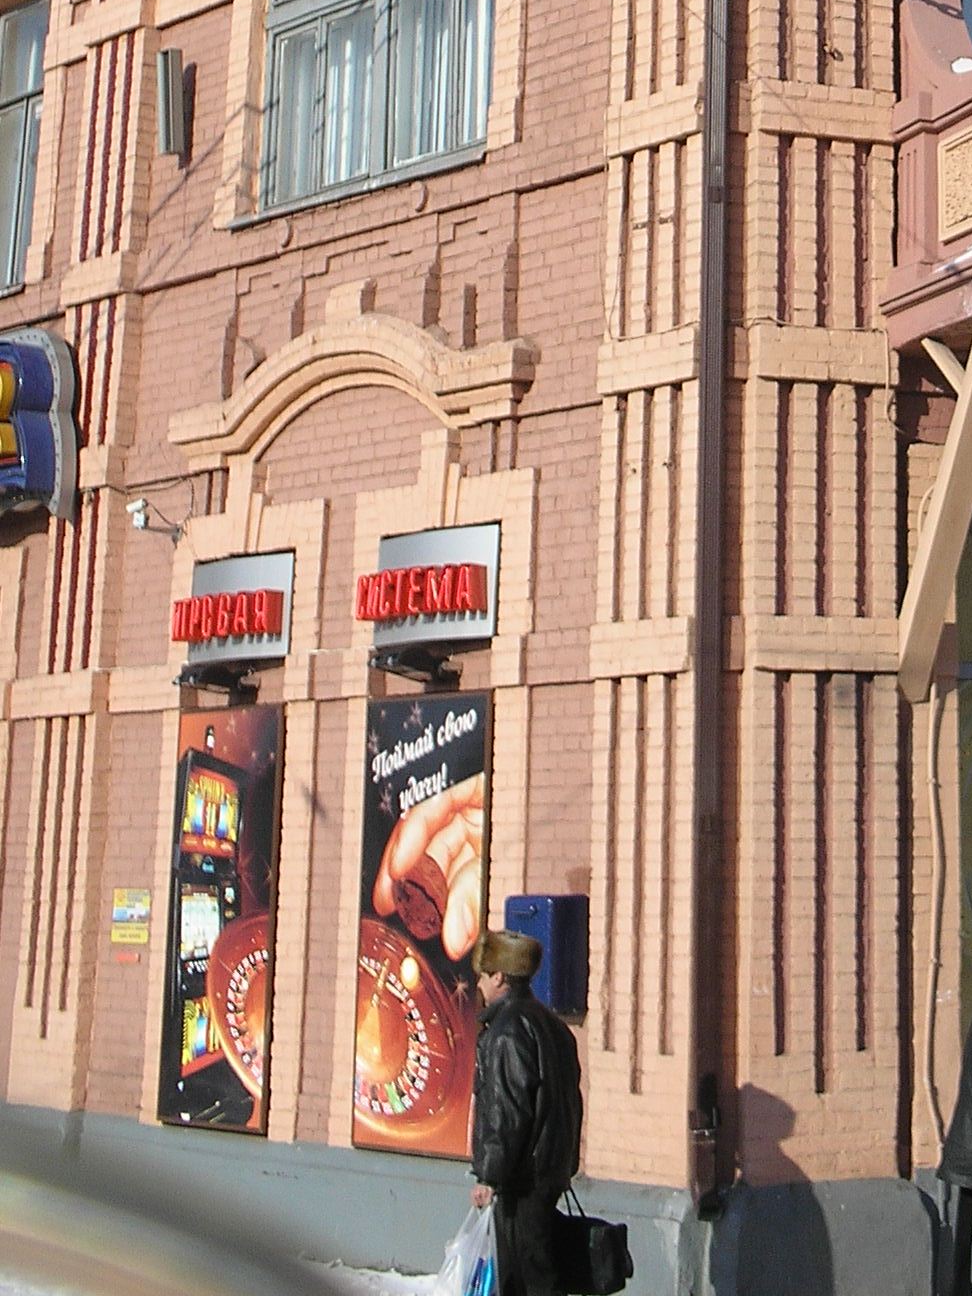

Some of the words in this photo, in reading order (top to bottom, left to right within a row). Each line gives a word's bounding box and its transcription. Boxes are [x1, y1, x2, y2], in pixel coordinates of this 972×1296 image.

[355, 563, 479, 621] СИСТЕМА
[371, 722, 434, 783] Поймай
[437, 708, 477, 746] свою
[399, 762, 448, 820] удачу!
